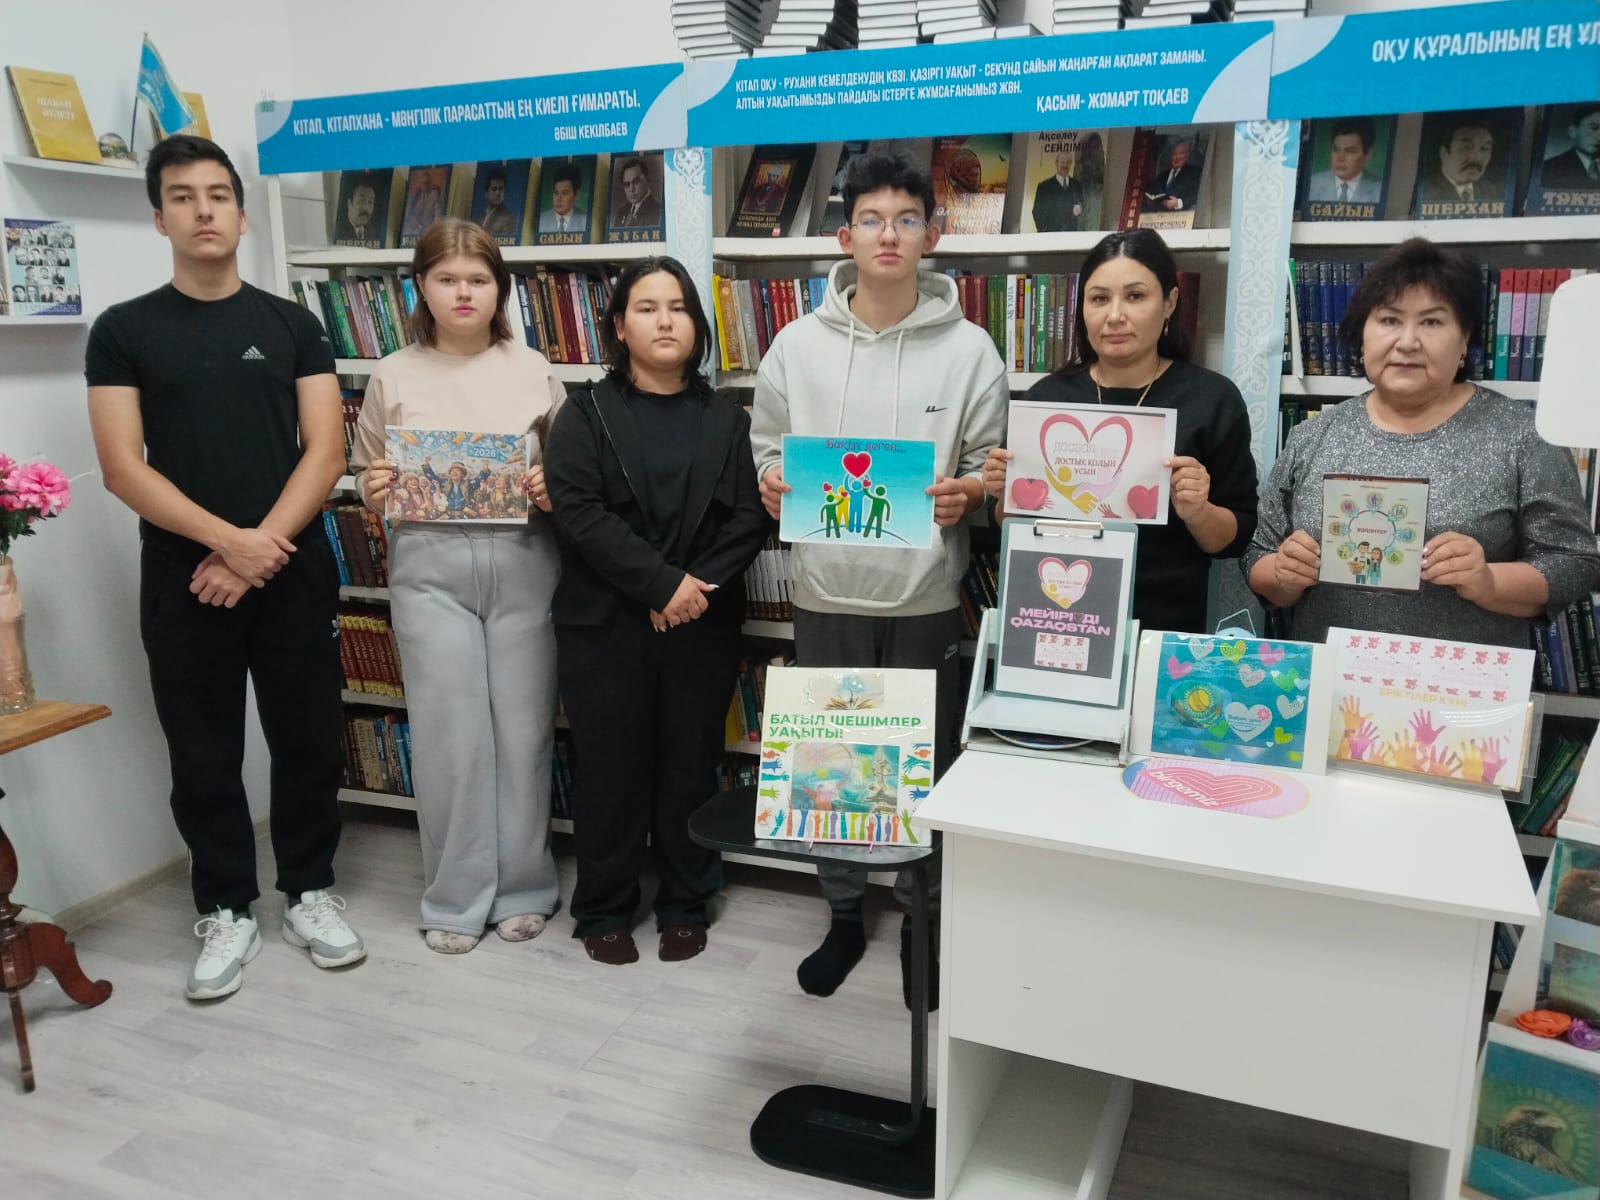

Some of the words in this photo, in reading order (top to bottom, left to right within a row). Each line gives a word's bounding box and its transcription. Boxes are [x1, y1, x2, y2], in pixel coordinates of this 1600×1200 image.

[1372, 38, 1410, 63] ОҚУ
[1413, 27, 1541, 61] ҚҰРАЛЫНЫҢ
[1545, 24, 1573, 49] ЕҢ
[736, 78, 759, 92] КІТАП
[760, 78, 777, 92] ОҚУ
[784, 75, 817, 90] РУХАНИ
[818, 72, 885, 88] КЕМЕЛДЕНУДІҢ
[910, 68, 944, 84] ҚАЗІРГІ
[945, 64, 977, 79] УАҚЫТ
[984, 61, 1021, 76] СЕКУНД
[1023, 57, 1056, 74] САЙЫН
[1059, 55, 1111, 72] ЖАҢАРҒАН
[1114, 52, 1158, 69] АҚПАРАТ
[1160, 48, 1207, 65] ЗАМАНЫ.
[736, 96, 765, 110] АЛТЫН
[766, 92, 836, 109] УАҚЫТЫМЫЗДЫ
[838, 89, 881, 105] ПАЙДАЛЫ
[882, 87, 916, 102] ІСТЕРГЕ
[917, 81, 997, 99] ЖҰМСАҒАНЫМЫЗ
[999, 80, 1022, 95] ЖӨН.
[1088, 90, 1140, 109] ЖОМАРТ
[1142, 88, 1189, 108] ТОҚАЕВ
[293, 118, 325, 136] КІТАП,
[327, 112, 383, 133] КІТАПХАНА
[443, 100, 516, 123] ПАРАСАТТЫҢ
[518, 99, 534, 119] ЕҢ
[535, 95, 569, 116] КИЕЛІ
[571, 89, 641, 113] ҒИМАРАТЫ.
[578, 122, 628, 139] КЕКІЛБАЕВ
[1310, 203, 1375, 217] САЙЫН
[1421, 202, 1505, 215] ШЕРХАН
[539, 232, 583, 244] САЙЫН
[1010, 617, 1111, 636] QAZAQSTAN
[770, 714, 825, 726] БАТЫЛ
[769, 726, 844, 740] УАҚЫТЫ!
